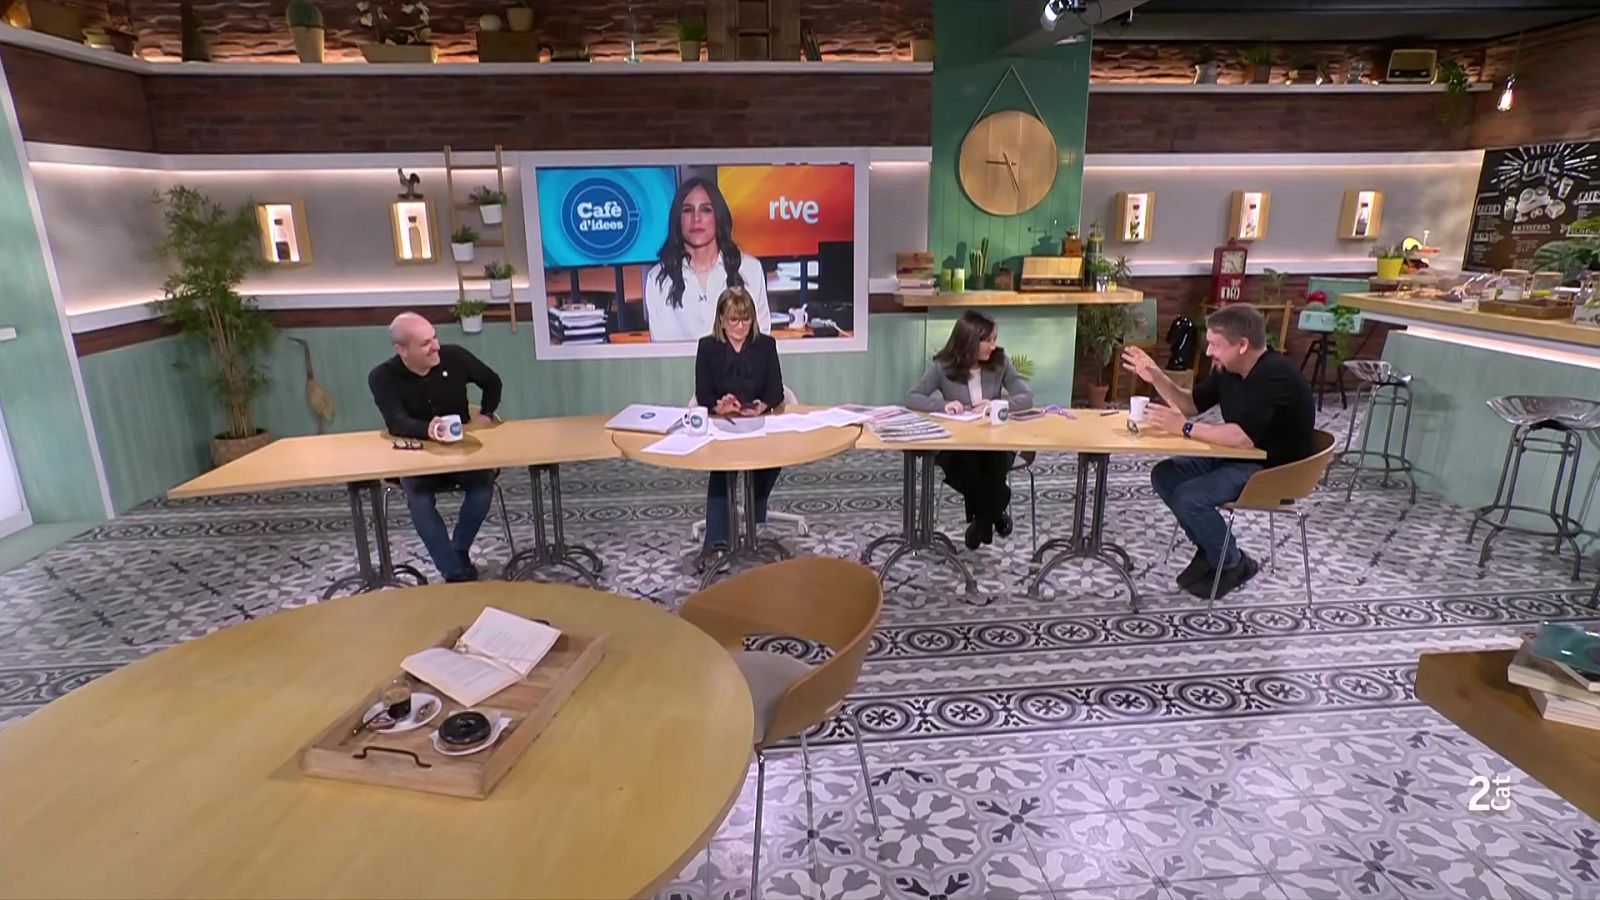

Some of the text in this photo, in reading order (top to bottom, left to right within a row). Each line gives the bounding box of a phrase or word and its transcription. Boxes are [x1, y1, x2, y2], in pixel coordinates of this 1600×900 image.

[577, 201, 622, 218] Cafè
[769, 195, 819, 224] rtve
[580, 219, 624, 231] d'idees
